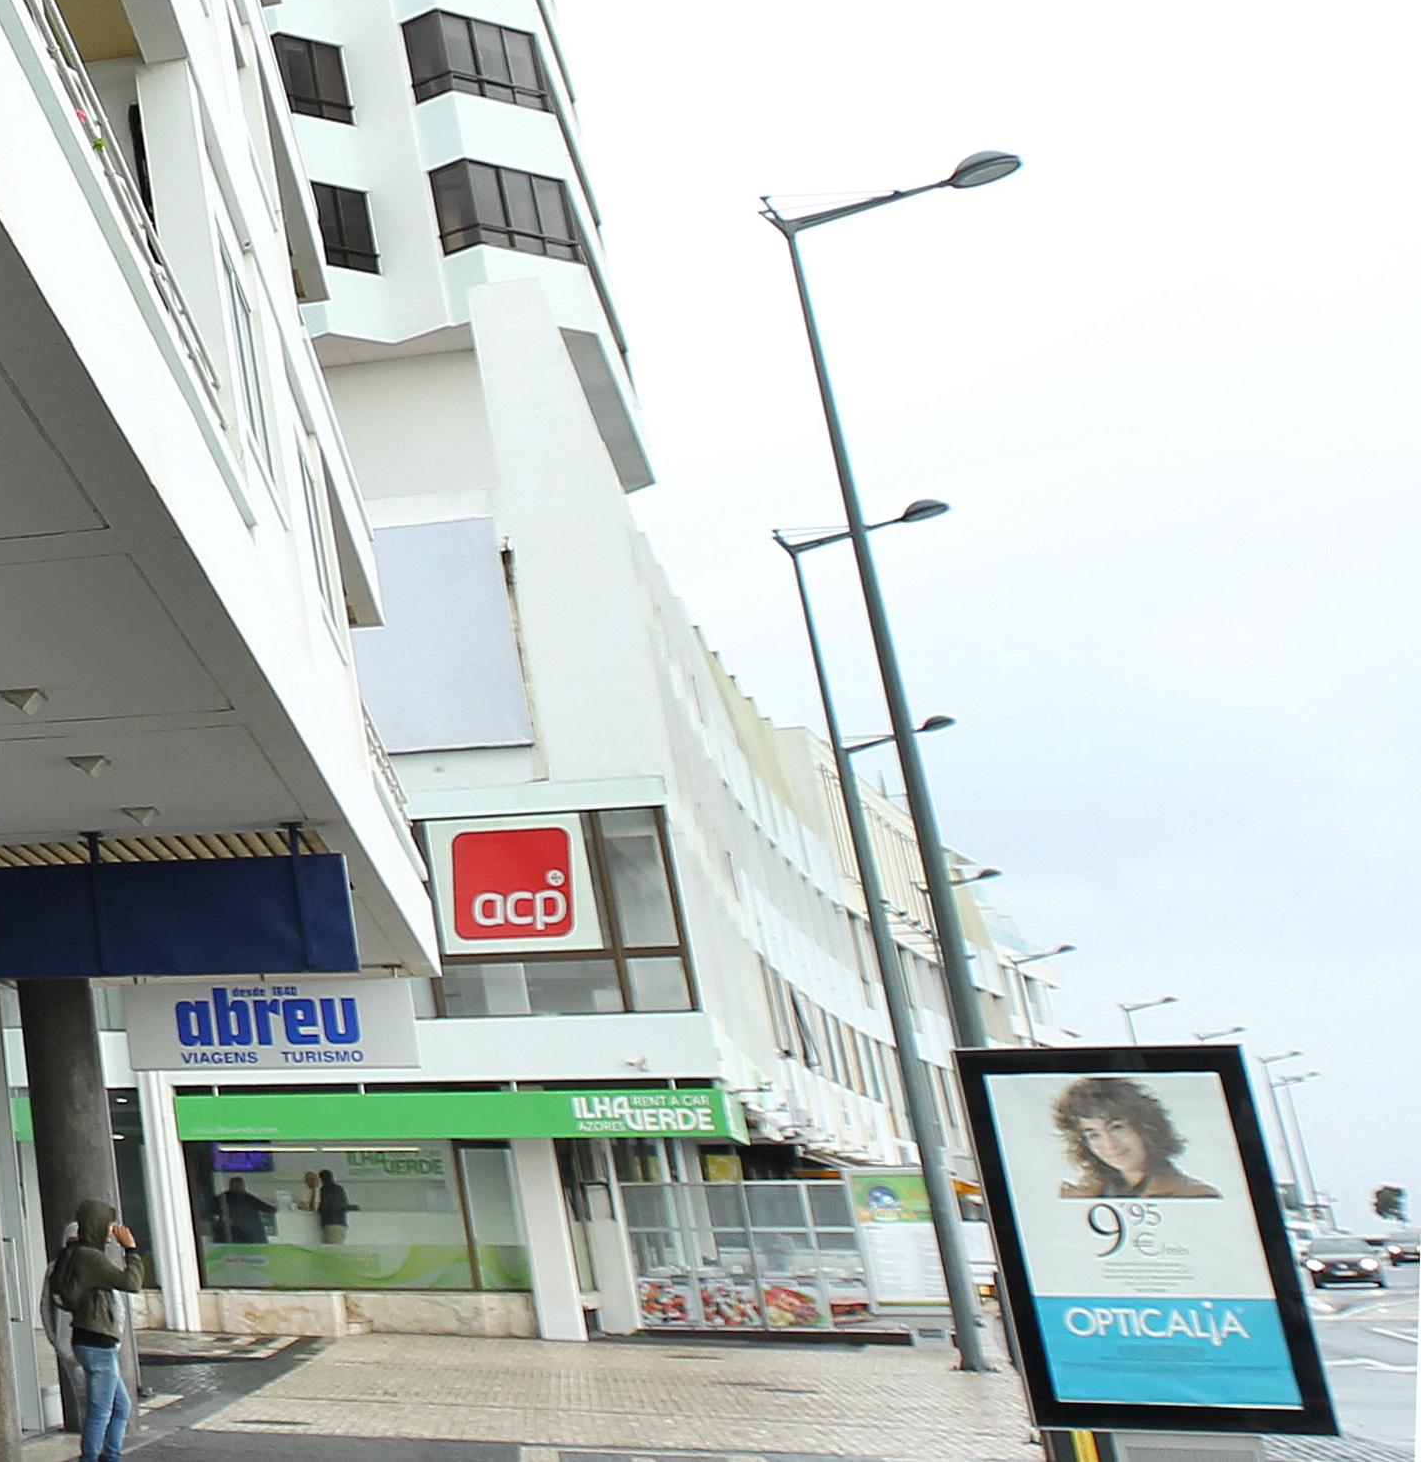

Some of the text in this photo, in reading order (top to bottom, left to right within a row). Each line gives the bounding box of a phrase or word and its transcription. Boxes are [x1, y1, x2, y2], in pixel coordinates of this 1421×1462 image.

[471, 891, 568, 931] acp
[175, 988, 361, 1047] abreu
[182, 1051, 364, 1064] VIAGENS TURISMO
[573, 1096, 629, 1119] ILHA
[632, 1095, 710, 1106] RENT A CAR
[579, 1121, 626, 1132] AZORES
[625, 1109, 715, 1132] VERDE
